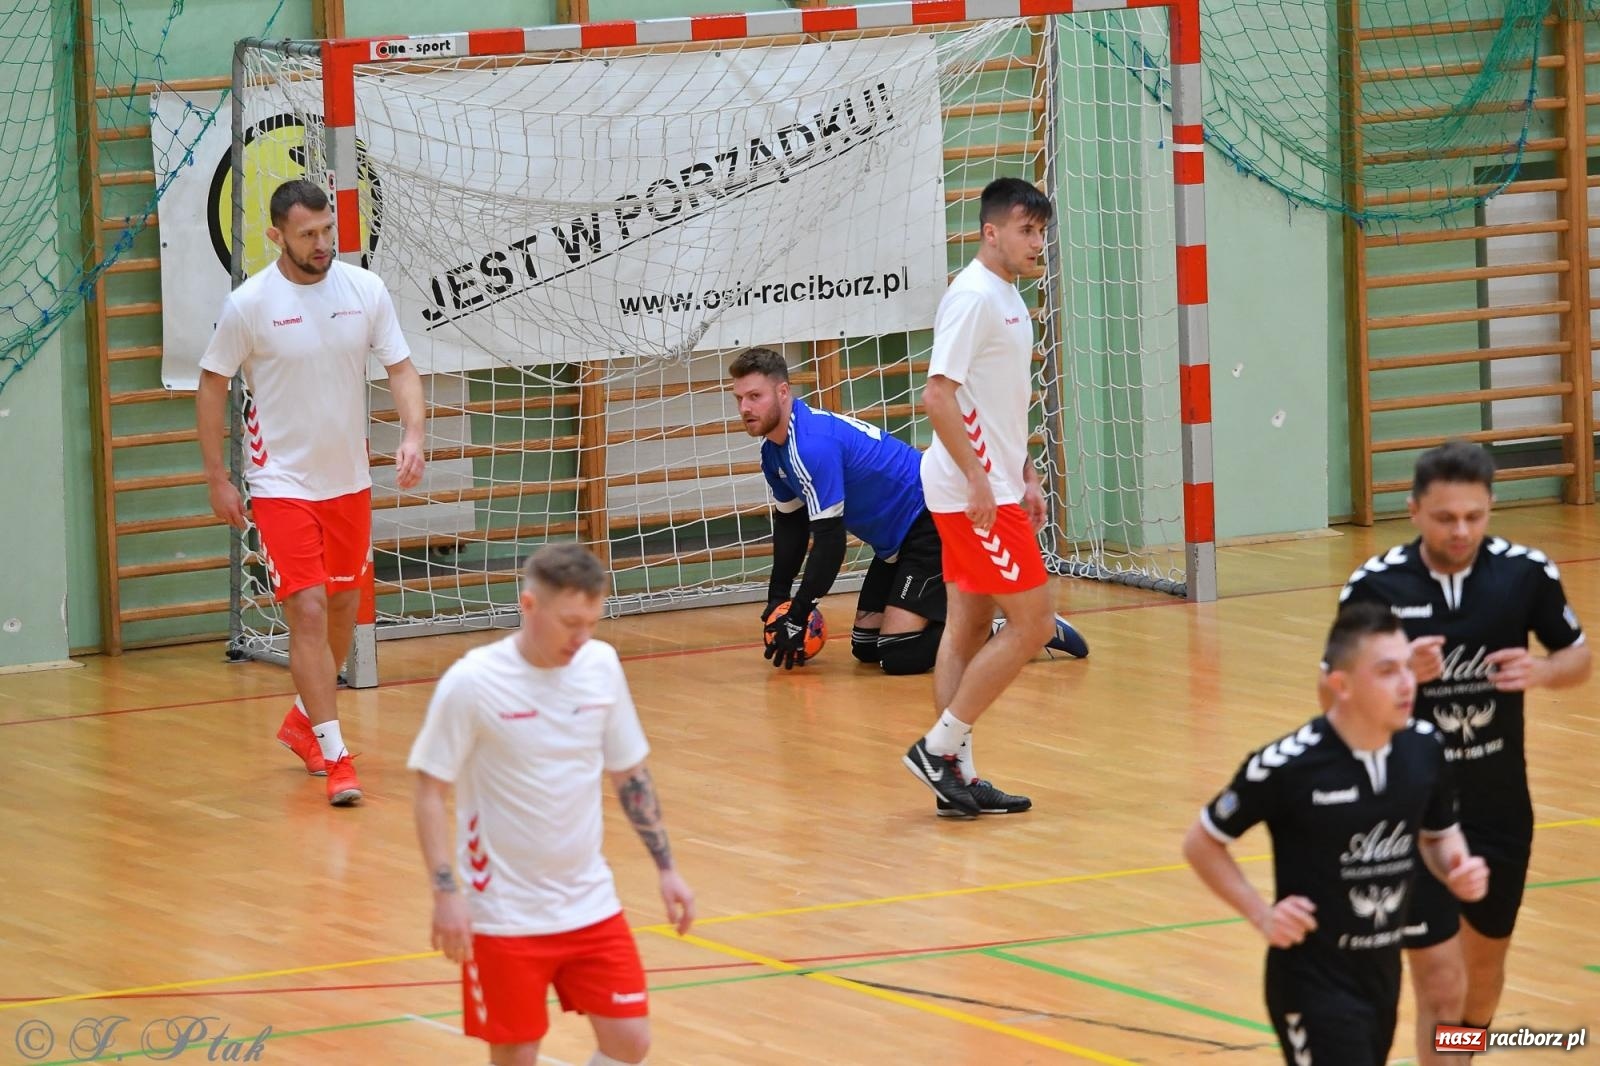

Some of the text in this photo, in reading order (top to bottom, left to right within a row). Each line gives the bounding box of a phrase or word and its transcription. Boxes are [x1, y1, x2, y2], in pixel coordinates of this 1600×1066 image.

[416, 40, 451, 55] sport
[422, 82, 895, 321] JEST W PORZĄDKU!
[619, 266, 909, 316] www.osir-raciborz.pl
[272, 315, 303, 327] hummel
